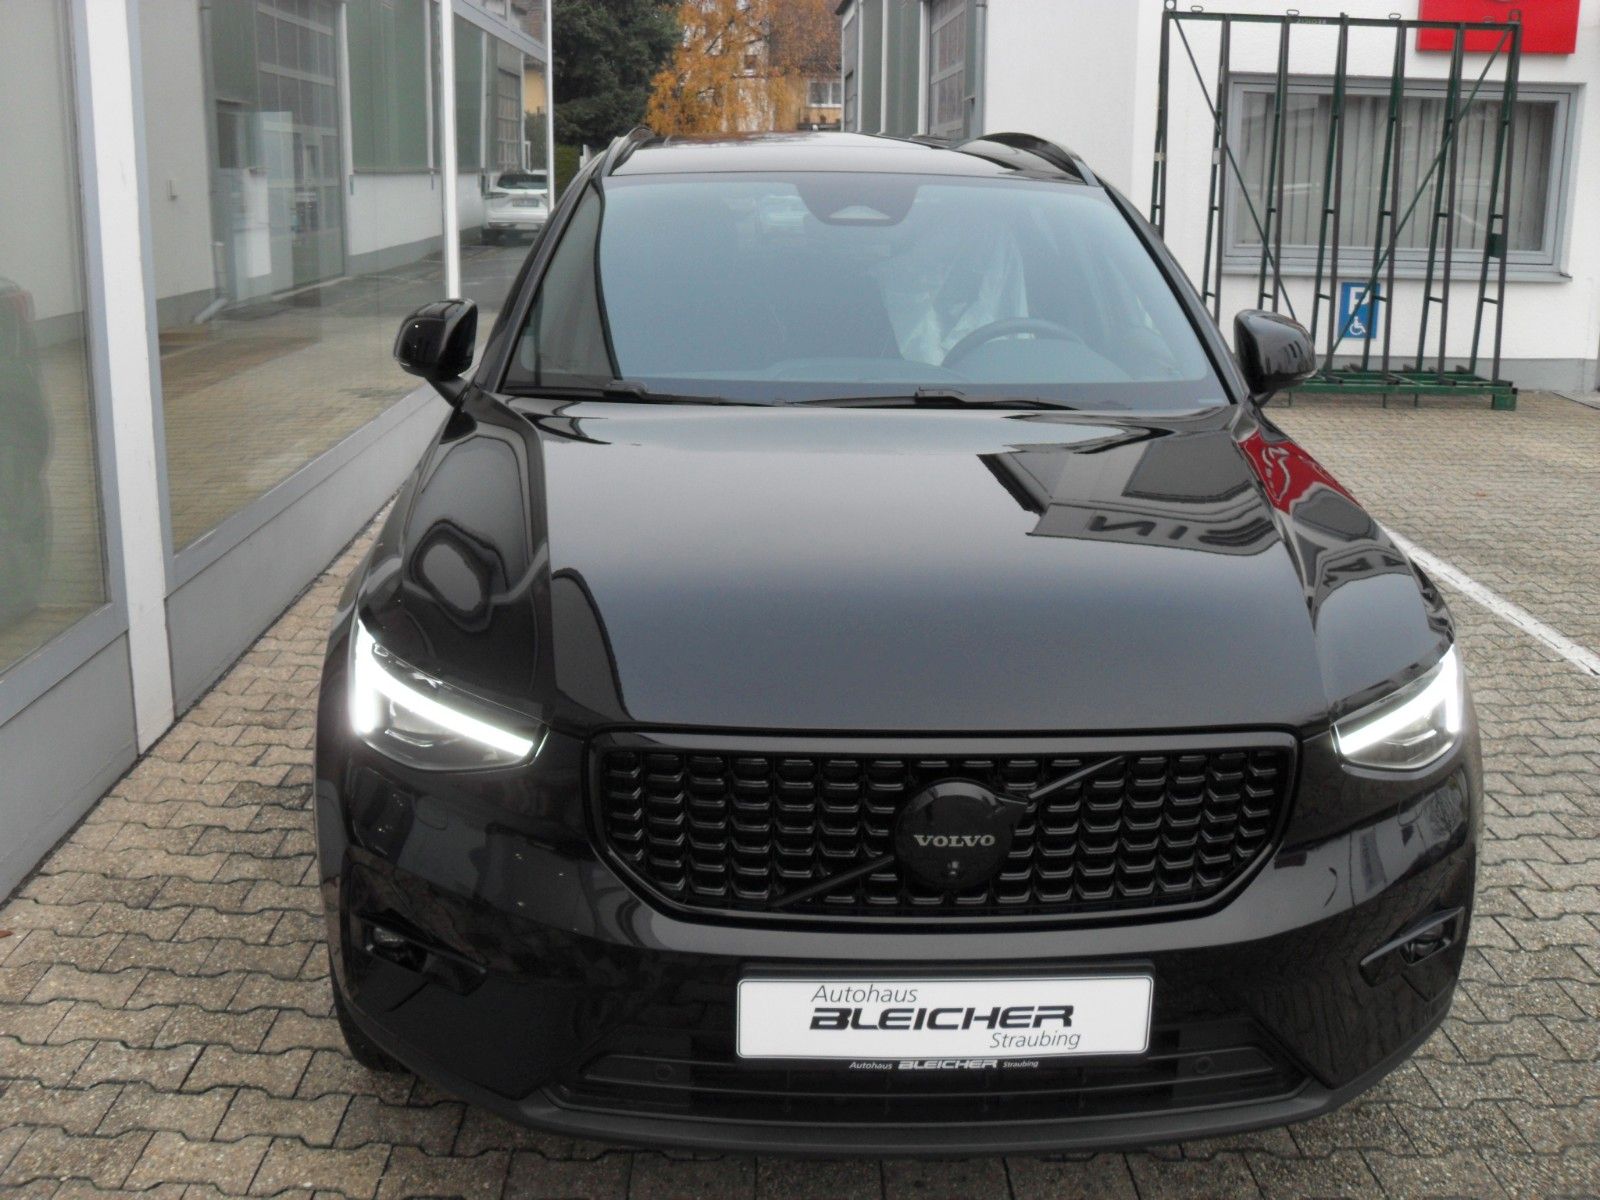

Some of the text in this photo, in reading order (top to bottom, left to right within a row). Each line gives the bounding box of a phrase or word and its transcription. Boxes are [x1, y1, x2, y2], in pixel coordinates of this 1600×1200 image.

[1349, 286, 1371, 315] P
[913, 834, 996, 848] VOLVO
[811, 983, 918, 1003] Autohaus
[809, 1005, 1074, 1030] BLEICHER
[989, 1030, 1082, 1050] Straubing
[849, 1059, 1039, 1070] Autohaus BLEICHER Straubing
